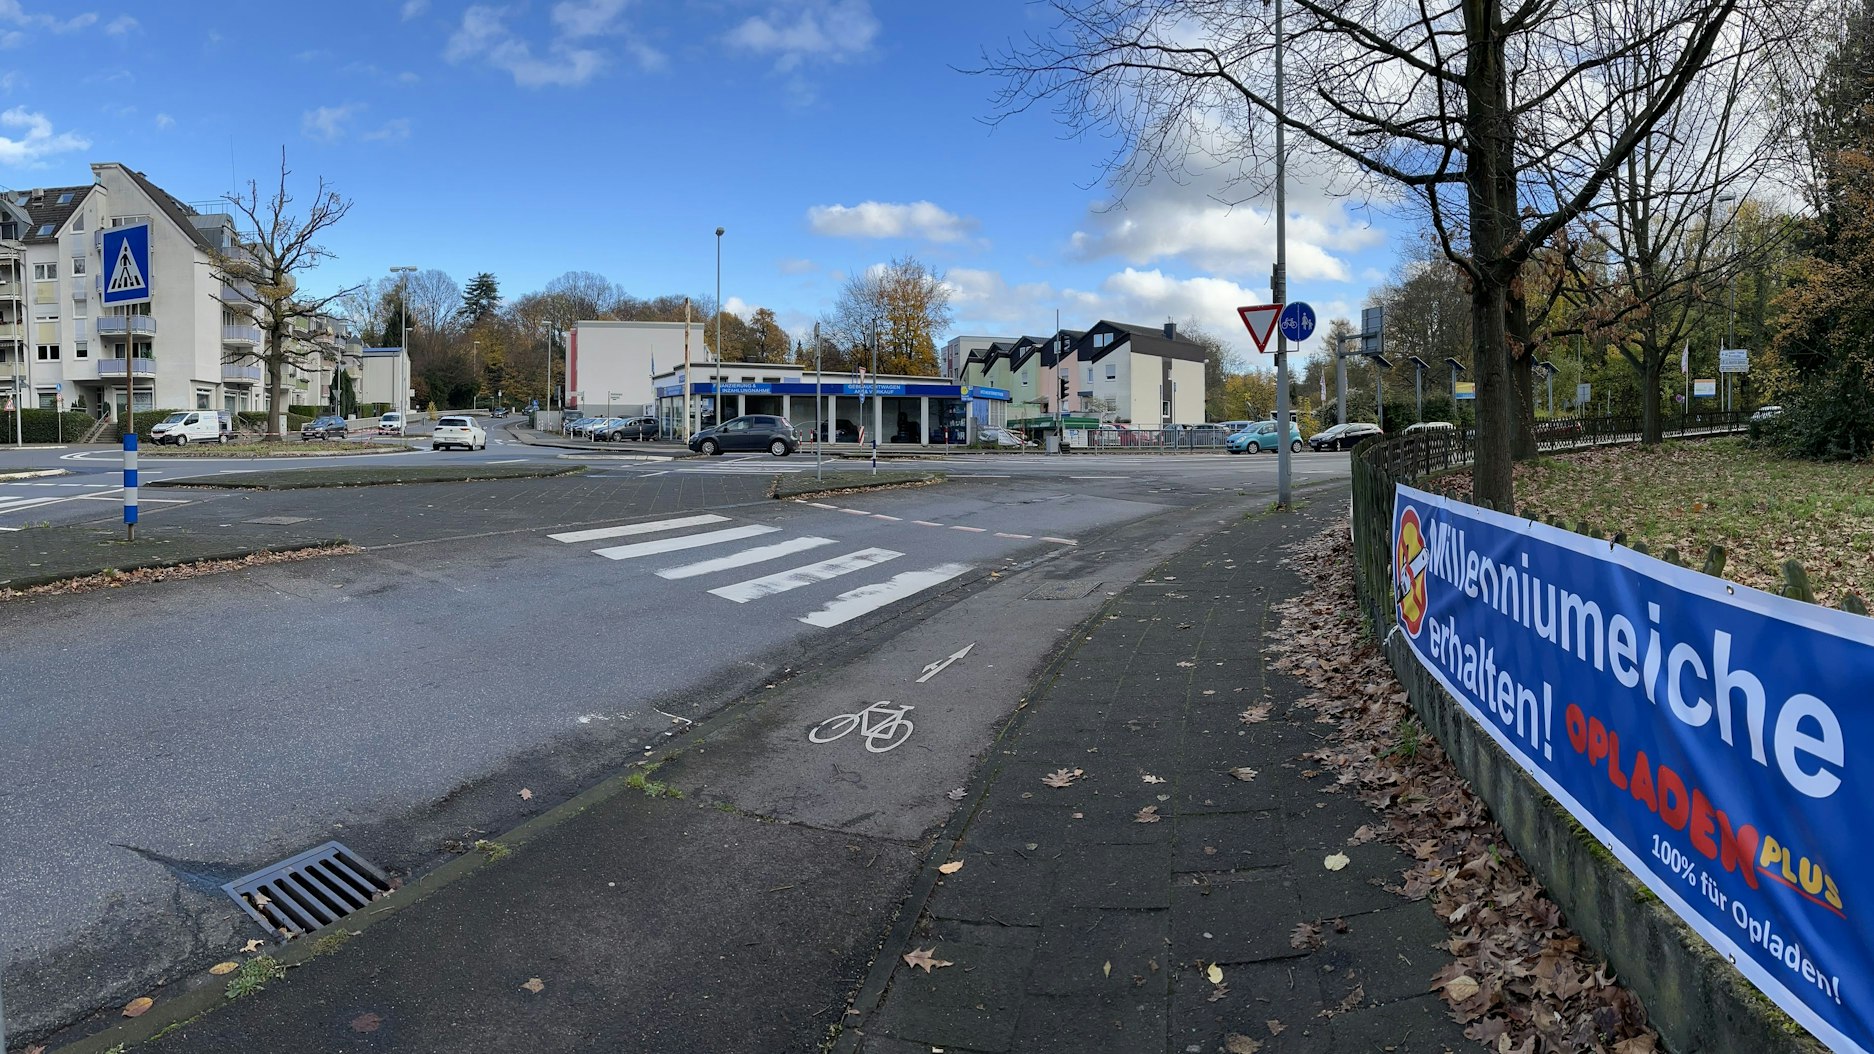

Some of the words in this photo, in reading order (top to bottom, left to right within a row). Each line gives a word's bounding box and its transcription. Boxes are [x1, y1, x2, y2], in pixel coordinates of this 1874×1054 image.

[1428, 518, 1845, 798] Millenniumeiche
[1428, 615, 1552, 761] erhalten!
[1565, 703, 1759, 890] OPLADEN
[1760, 835, 1843, 910] PLUS
[1651, 833, 1697, 887] 100%
[1700, 870, 1728, 912] für
[1732, 900, 1841, 1006] Opladen!
